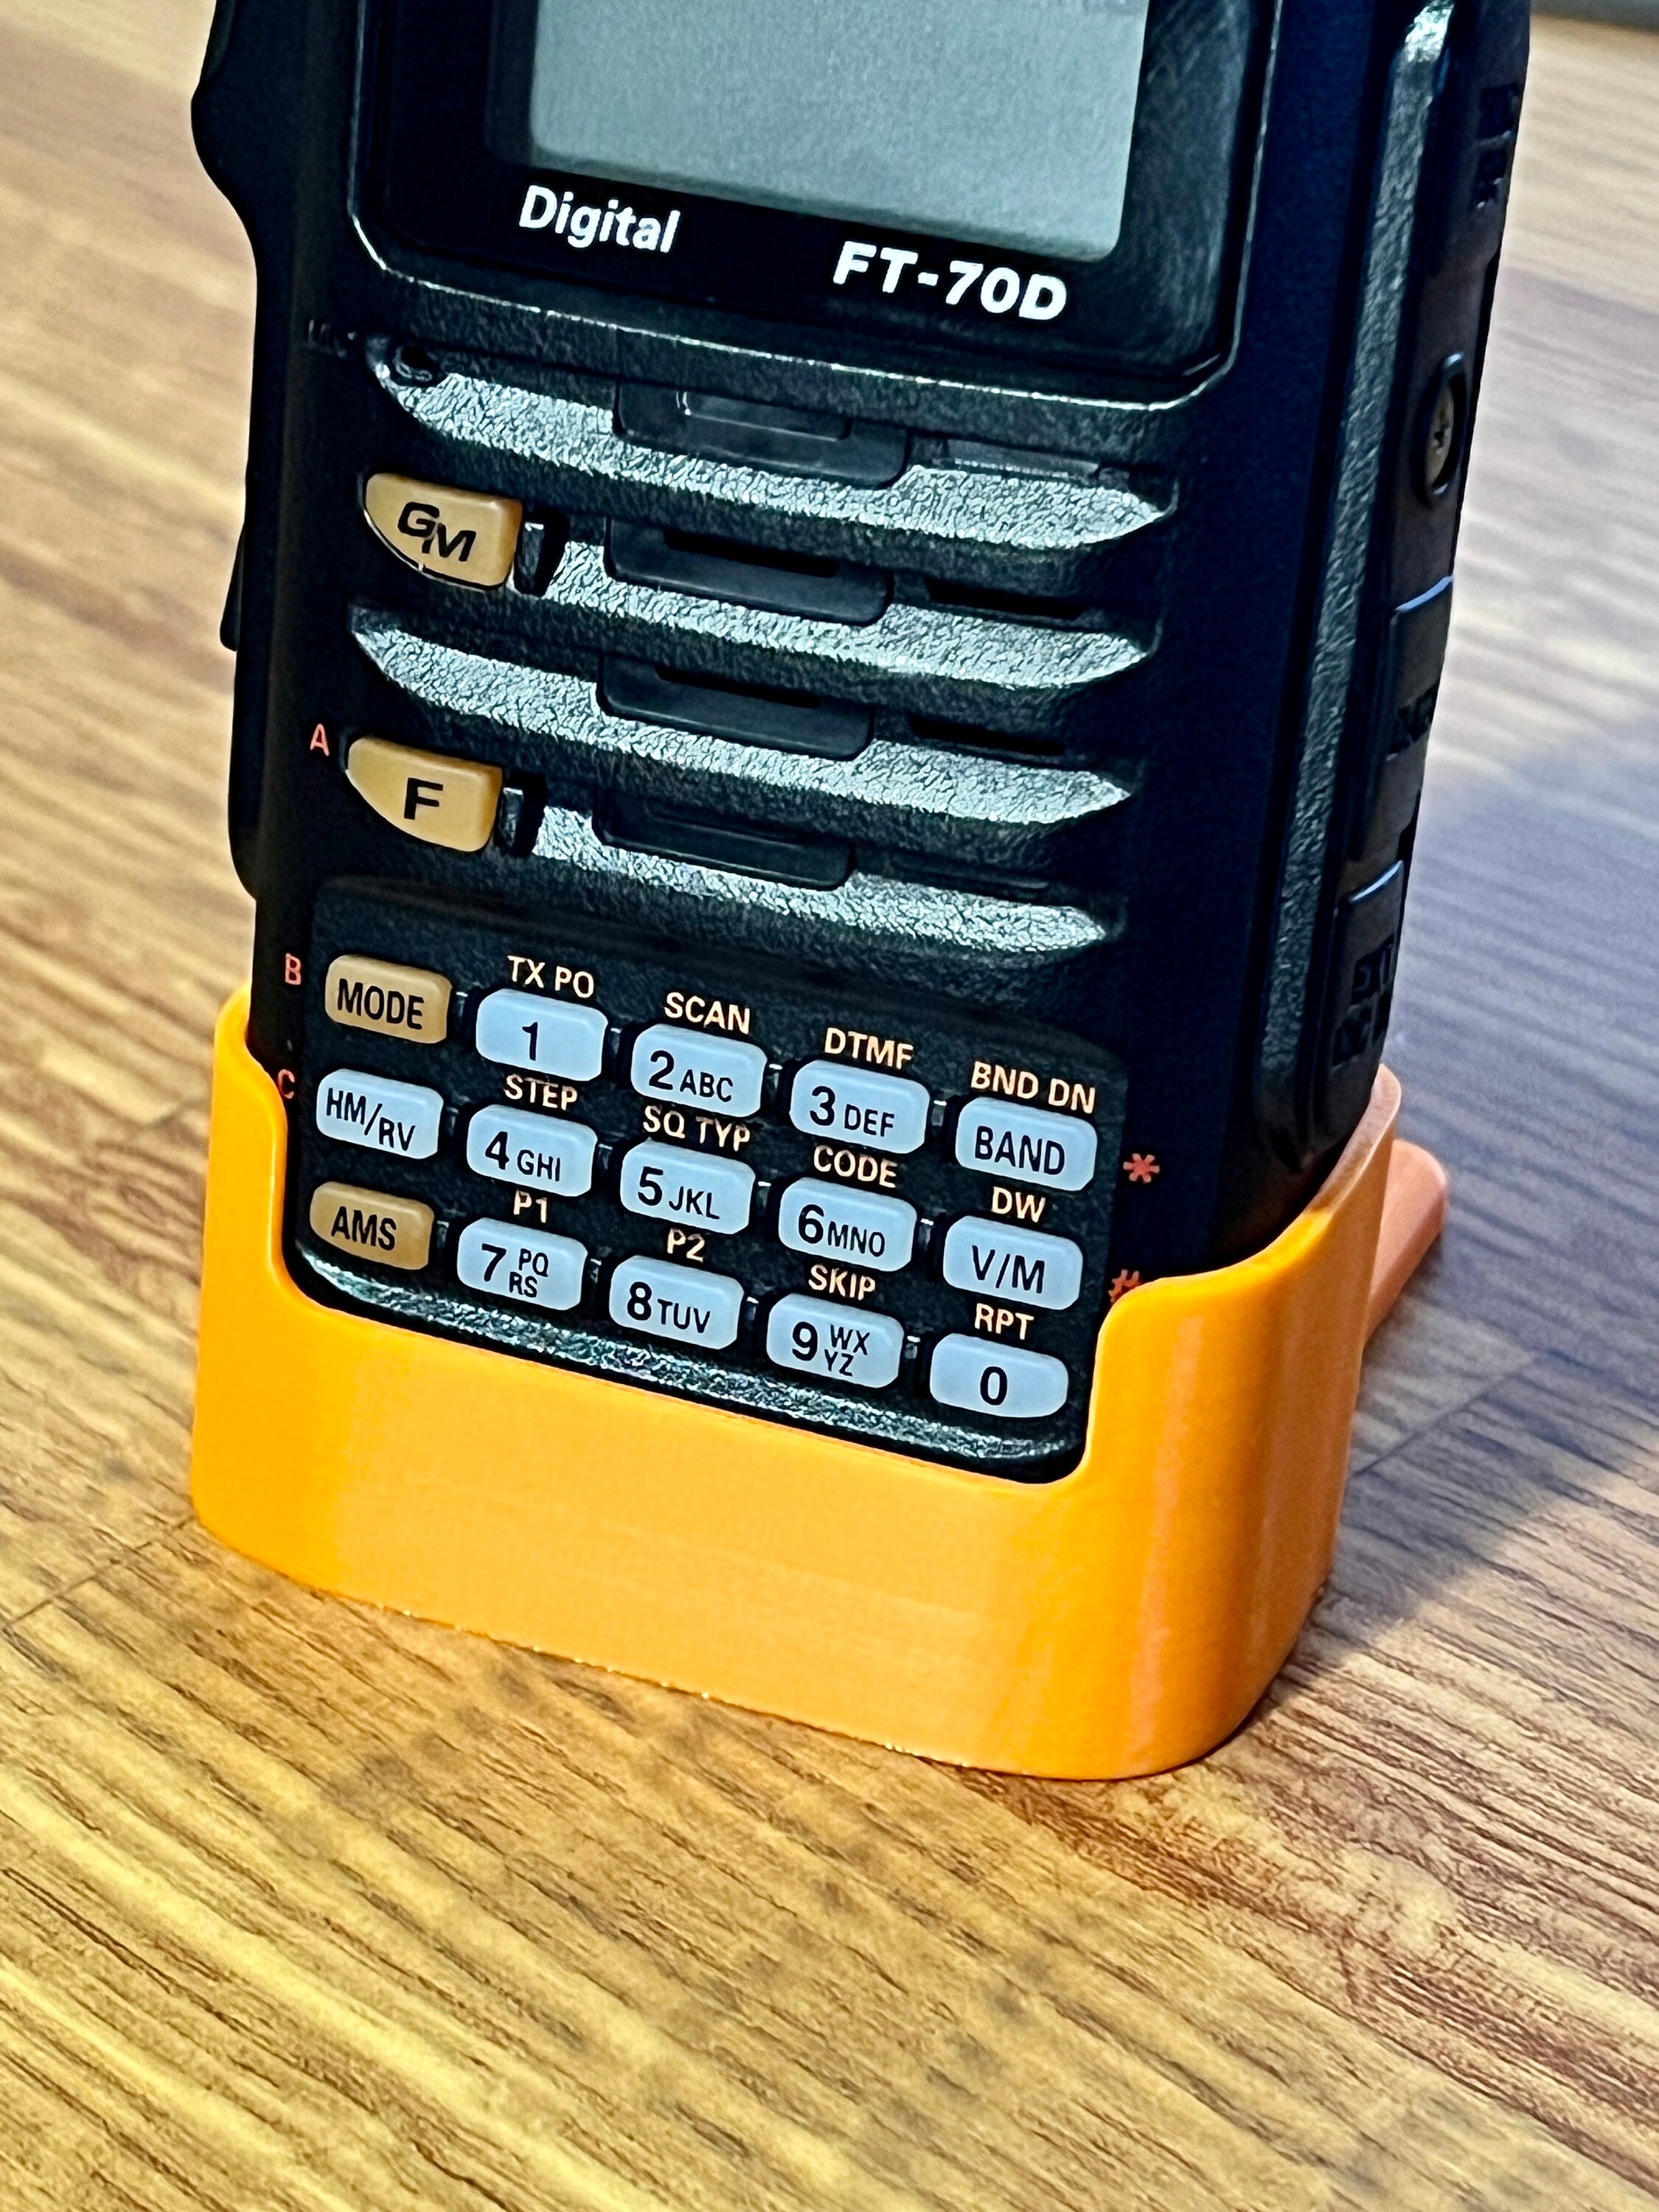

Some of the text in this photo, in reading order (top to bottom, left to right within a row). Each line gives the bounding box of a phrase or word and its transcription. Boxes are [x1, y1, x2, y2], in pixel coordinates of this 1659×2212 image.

[518, 184, 681, 254] Digital
[832, 240, 1068, 321] FT-70D
[310, 723, 330, 757] A
[403, 777, 443, 820] F
[284, 953, 302, 985] B
[507, 956, 595, 998] TX PO
[337, 979, 425, 1030] MODE
[664, 992, 751, 1035] SCAN
[522, 1020, 539, 1062] 1
[824, 1028, 914, 1070] DTMF
[277, 1068, 296, 1099] C
[504, 1074, 578, 1110] STEP
[647, 1050, 734, 1103] 2 ABC
[971, 1061, 1096, 1114] BND DN
[326, 1088, 416, 1152] HM/RV
[642, 1106, 751, 1152] SQ TYP
[809, 1085, 895, 1138] 3 DEF
[485, 1131, 562, 1183] 4 GHI
[813, 1144, 898, 1189] CODE
[974, 1126, 1065, 1175] BAND
[512, 1190, 549, 1223] P1
[637, 1167, 721, 1221] 5 JKL
[991, 1186, 1046, 1223] DW
[330, 1206, 397, 1251] AMS
[667, 1228, 705, 1263] P2
[797, 1204, 886, 1258] 6 MNO
[480, 1242, 549, 1282] 7 PQ
[808, 1265, 877, 1302] SKIP
[971, 1245, 1046, 1294] V/M
[508, 1272, 538, 1299] RS
[627, 1281, 712, 1334] 8 TUV
[974, 1303, 1034, 1341] RPT
[791, 1321, 870, 1363] 9 WX
[824, 1350, 855, 1377] YZ
[979, 1366, 1009, 1407] 0
